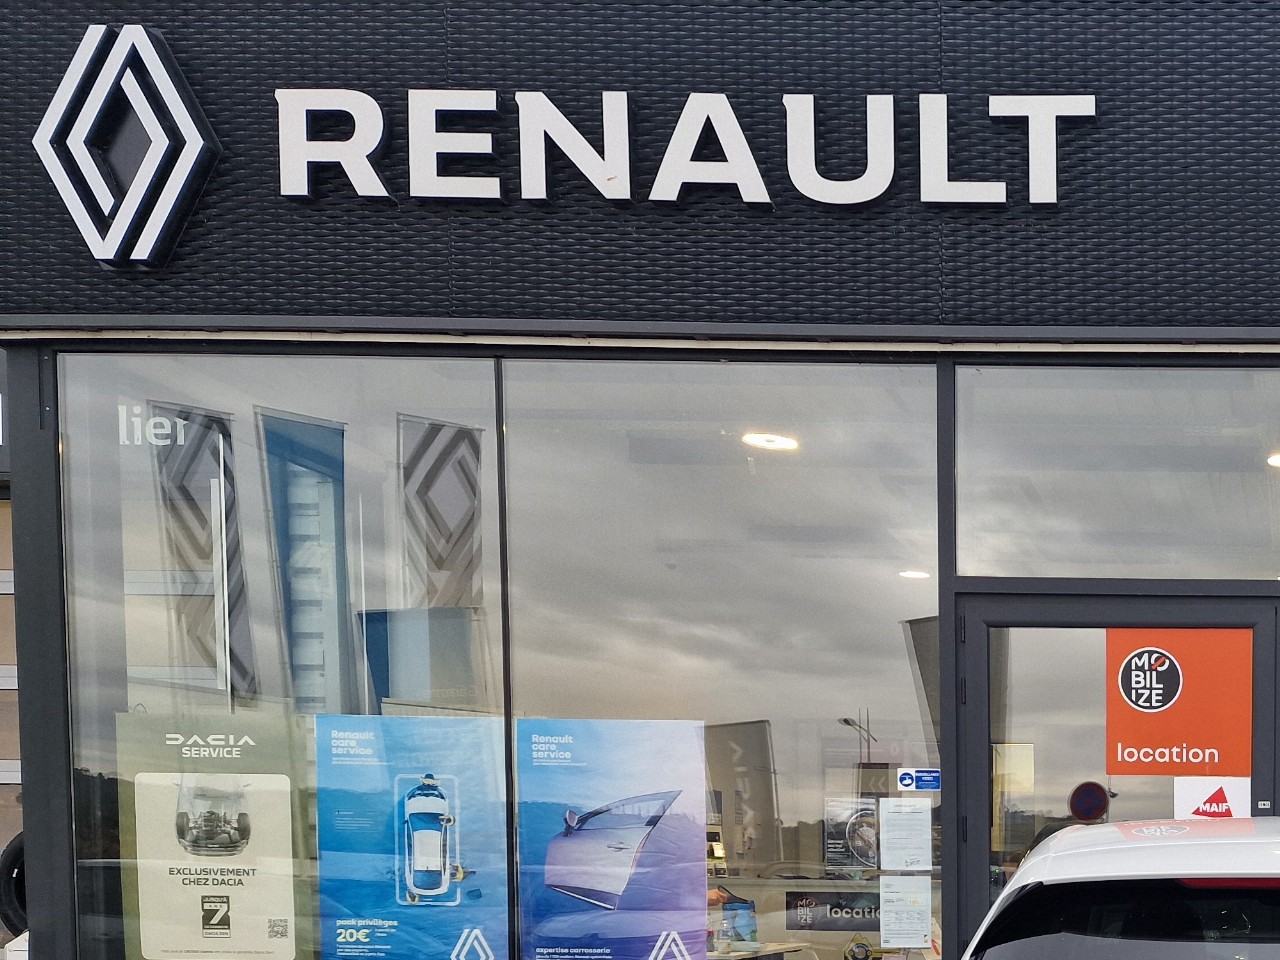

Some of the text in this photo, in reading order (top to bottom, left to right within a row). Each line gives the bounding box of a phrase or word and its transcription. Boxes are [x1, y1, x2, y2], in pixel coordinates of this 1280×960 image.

[275, 89, 1096, 204] RENAULT
[331, 730, 375, 739] Renault
[532, 734, 574, 743] Renault
[166, 733, 257, 746] DACIA
[182, 747, 241, 758] SERVICE
[331, 747, 373, 755] service
[532, 750, 572, 758] service
[1117, 743, 1220, 763] location
[1199, 803, 1230, 814] MAIF
[168, 867, 258, 876] EXCLUSIVEMENT
[182, 877, 245, 886] CHEZ DACIA
[203, 903, 229, 924] 7
[535, 946, 569, 954] expertise
